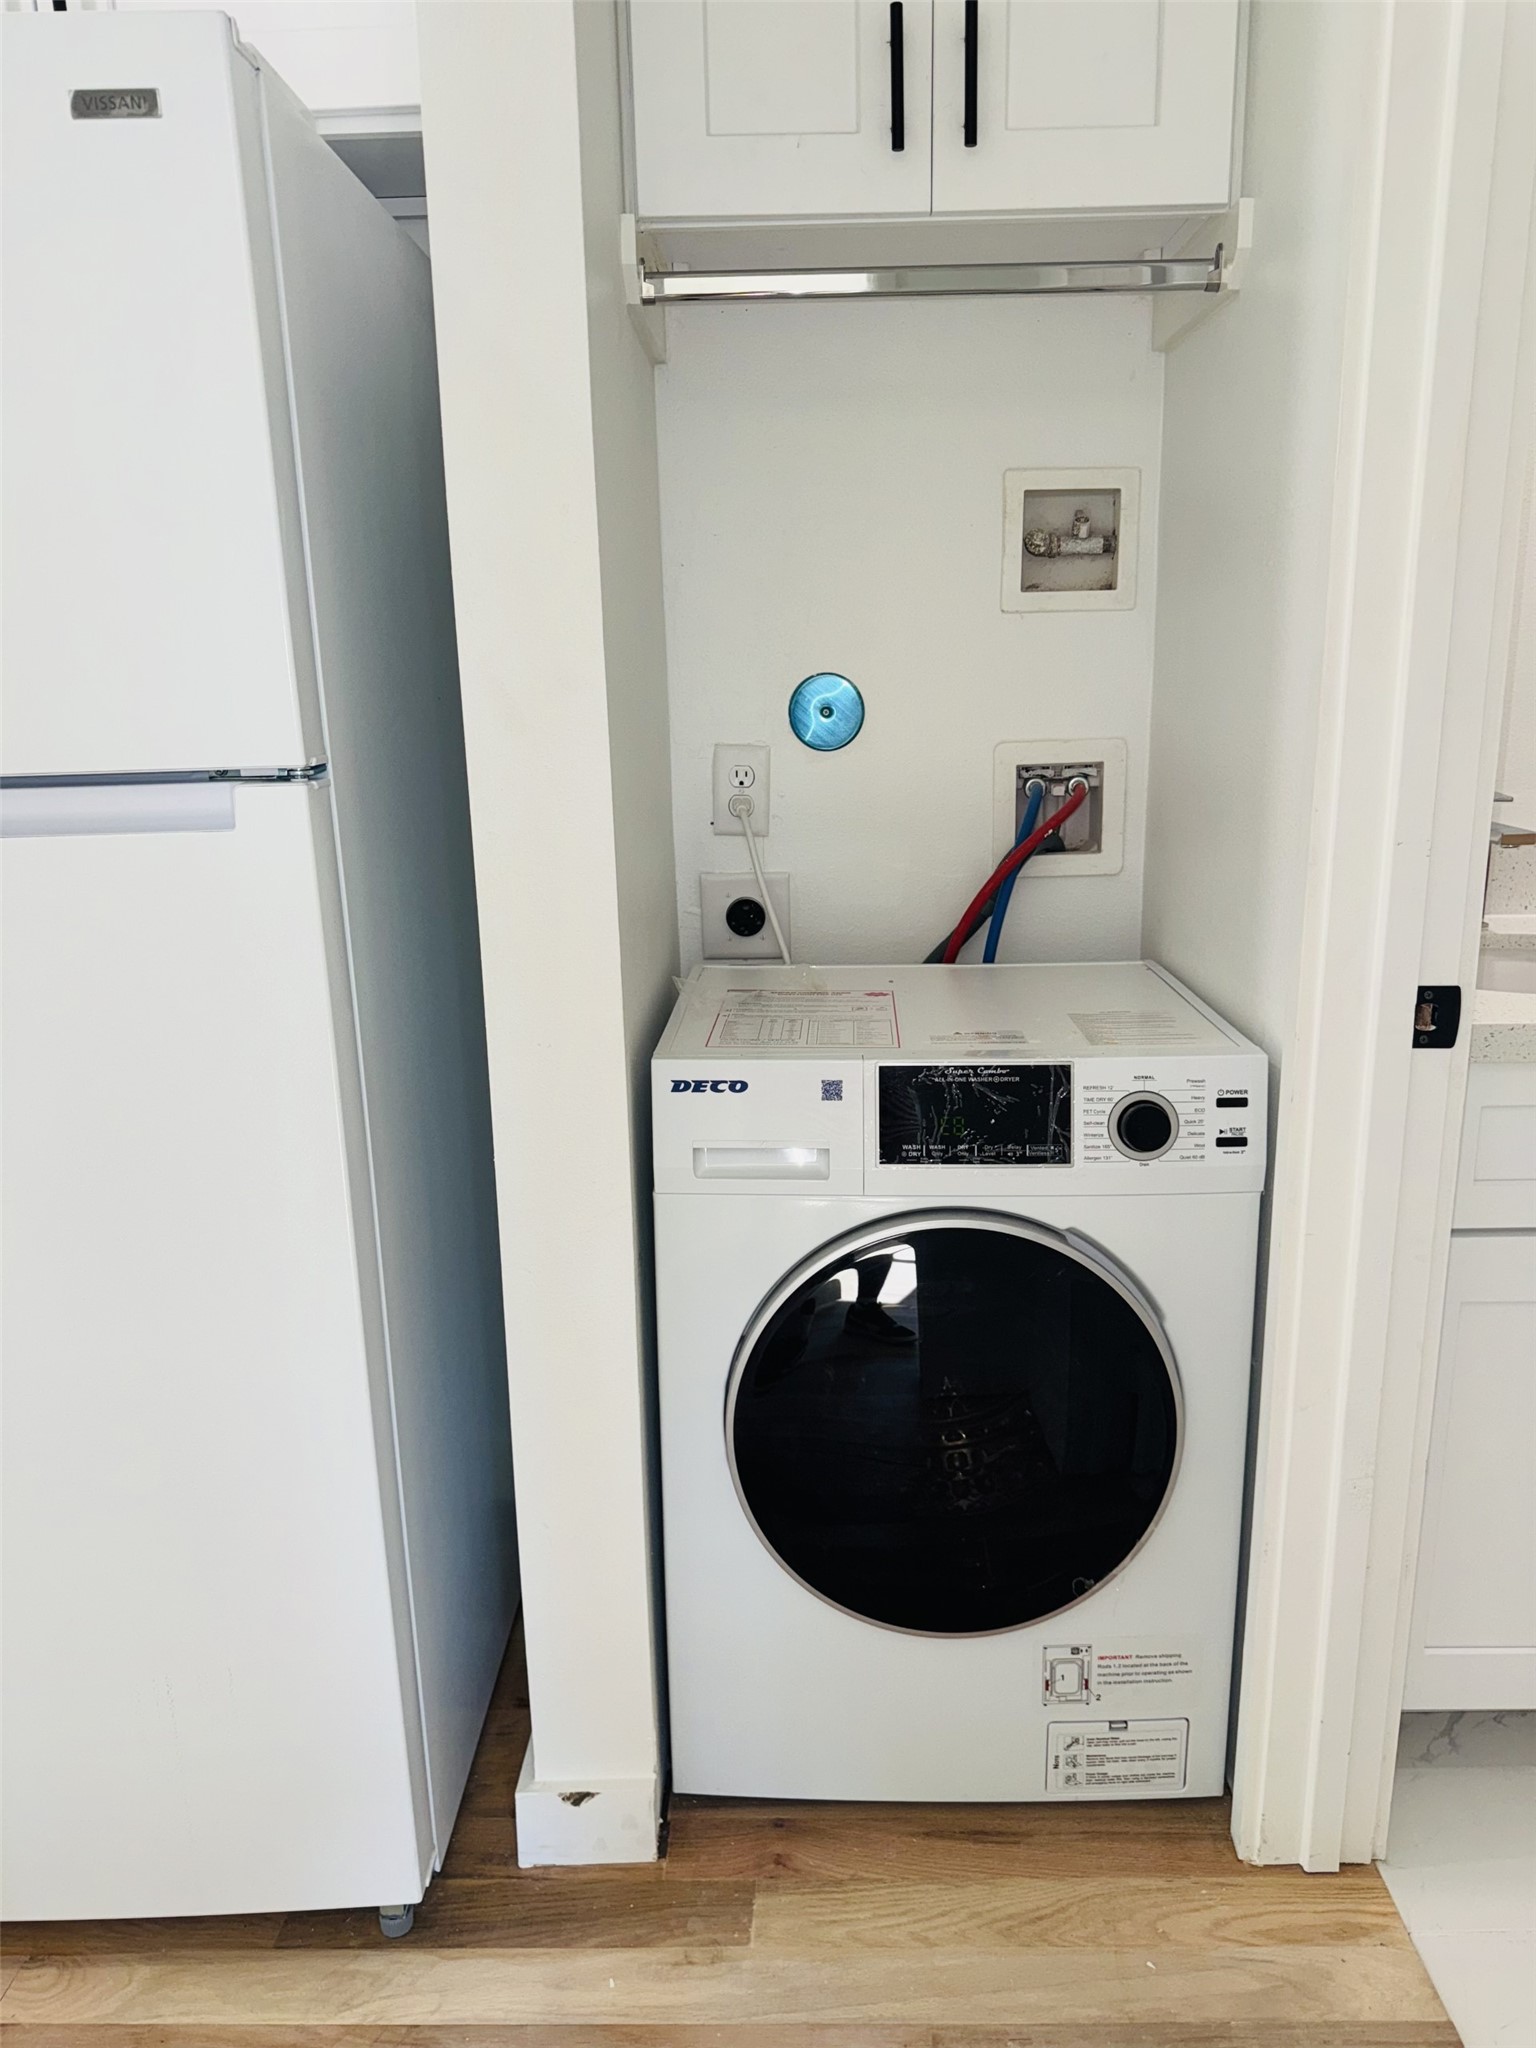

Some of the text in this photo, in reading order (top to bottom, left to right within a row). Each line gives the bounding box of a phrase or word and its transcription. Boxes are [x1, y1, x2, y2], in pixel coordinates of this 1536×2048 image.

[670, 1079, 749, 1093] DECO
[1158, 1652, 1182, 1660] shipping
[1095, 1693, 1102, 1701] 2
